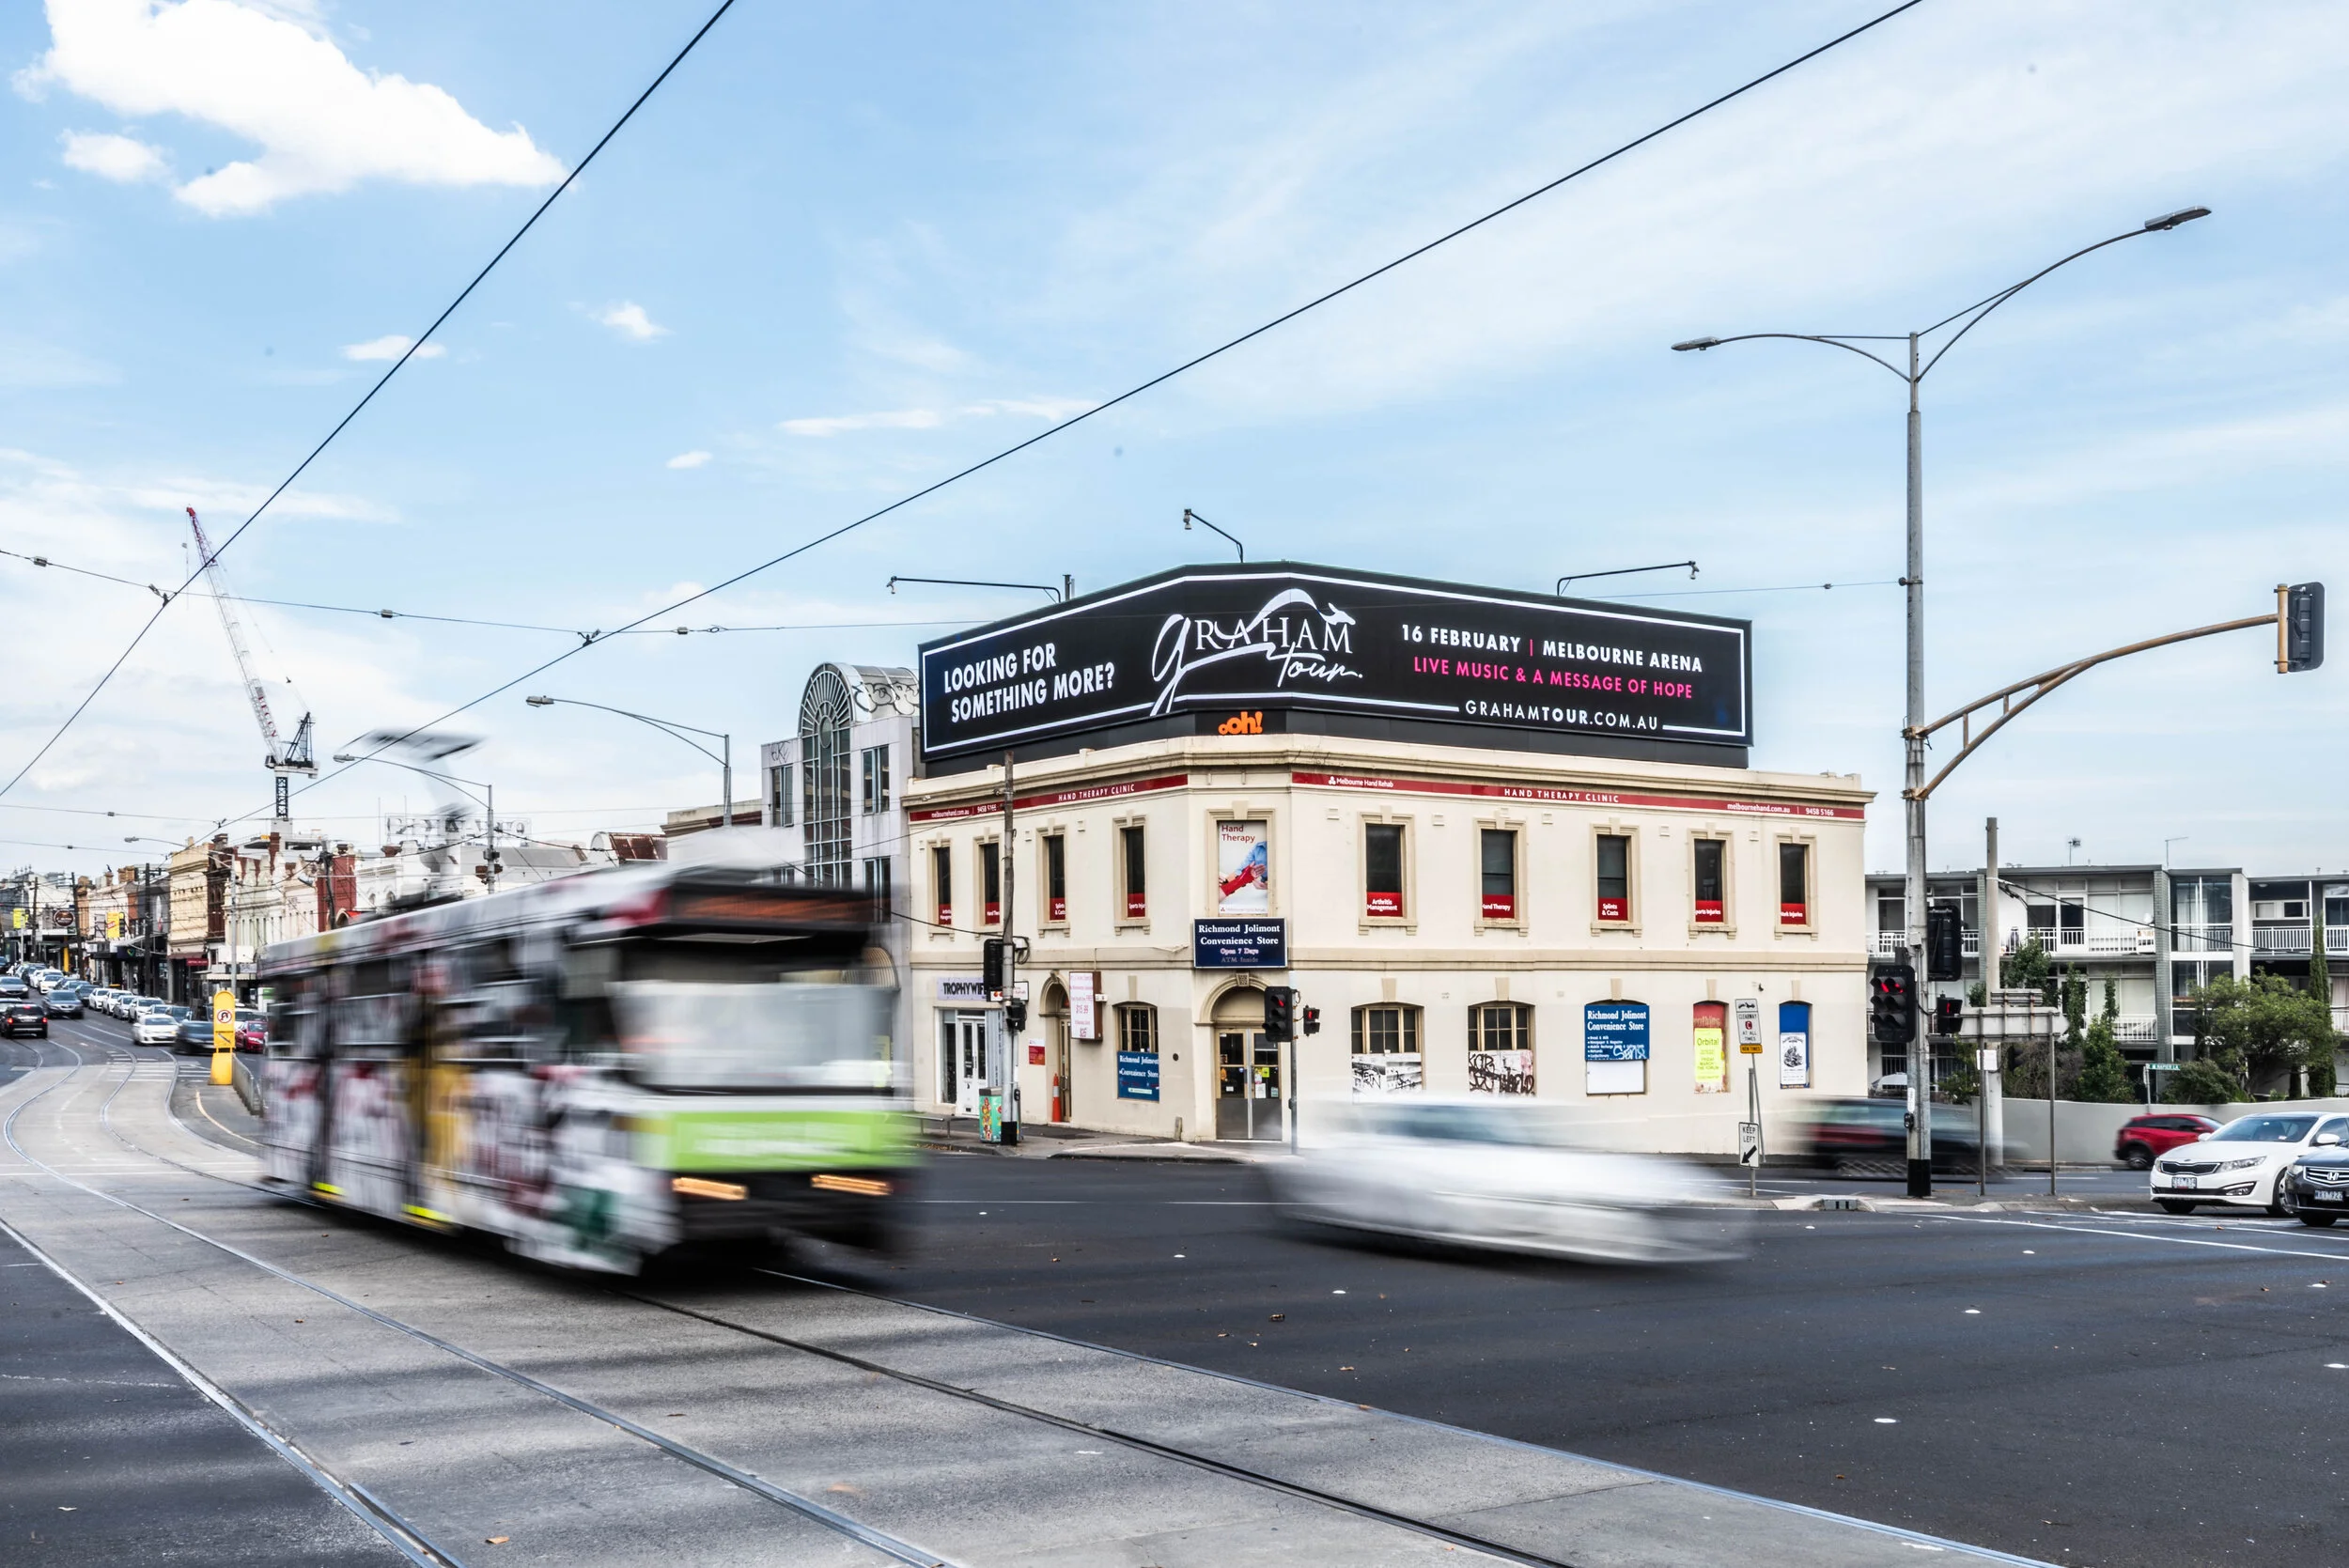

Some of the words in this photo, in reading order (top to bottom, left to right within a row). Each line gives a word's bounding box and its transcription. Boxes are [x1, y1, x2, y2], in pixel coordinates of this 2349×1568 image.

[1402, 624, 1423, 643] 16
[1430, 628, 1520, 654] FEBRUARY
[1542, 640, 1644, 666] MELBOURNE
[1649, 653, 1703, 673] ARENA
[944, 652, 1018, 693] LOOKING
[1022, 643, 1057, 675] FOR
[1414, 657, 1450, 675] LIVE
[1455, 662, 1509, 681] MUSIC
[1516, 667, 1528, 683] &
[1532, 669, 1545, 685] A
[1549, 671, 1622, 692] MESSAGE
[1627, 678, 1648, 695] OF
[1654, 681, 1693, 699] HOPE
[951, 678, 1048, 723] SOMETHING
[1053, 661, 1115, 701] MORE?
[1465, 700, 1657, 731] GRAHAMTOUR.COM.AU
[1336, 777, 1362, 786] Melbourne
[1364, 778, 1377, 787] Hand
[1378, 780, 1393, 788] Rehab
[1058, 792, 1076, 801] HAND
[1080, 787, 1108, 799] THERAPY
[1111, 784, 1135, 795] CLINIC
[1504, 788, 1532, 798] HAND
[1537, 790, 1580, 800] THERAPY
[1585, 793, 1619, 803] CLINIC
[1727, 803, 1791, 814] melbournehand.com.au
[1805, 807, 1819, 815] 9458
[1820, 808, 1834, 816] 5166
[1221, 833, 1255, 844] Therapy
[1198, 924, 1240, 933] Richmond
[1244, 924, 1280, 934] Jolimont
[1200, 937, 1252, 945] Convenience
[1256, 936, 1279, 945] Store
[1587, 1010, 1619, 1019] Richmond
[1621, 1010, 1647, 1021] Jolimont
[1587, 1021, 1626, 1031] Convenience
[1628, 1021, 1644, 1030] Store
